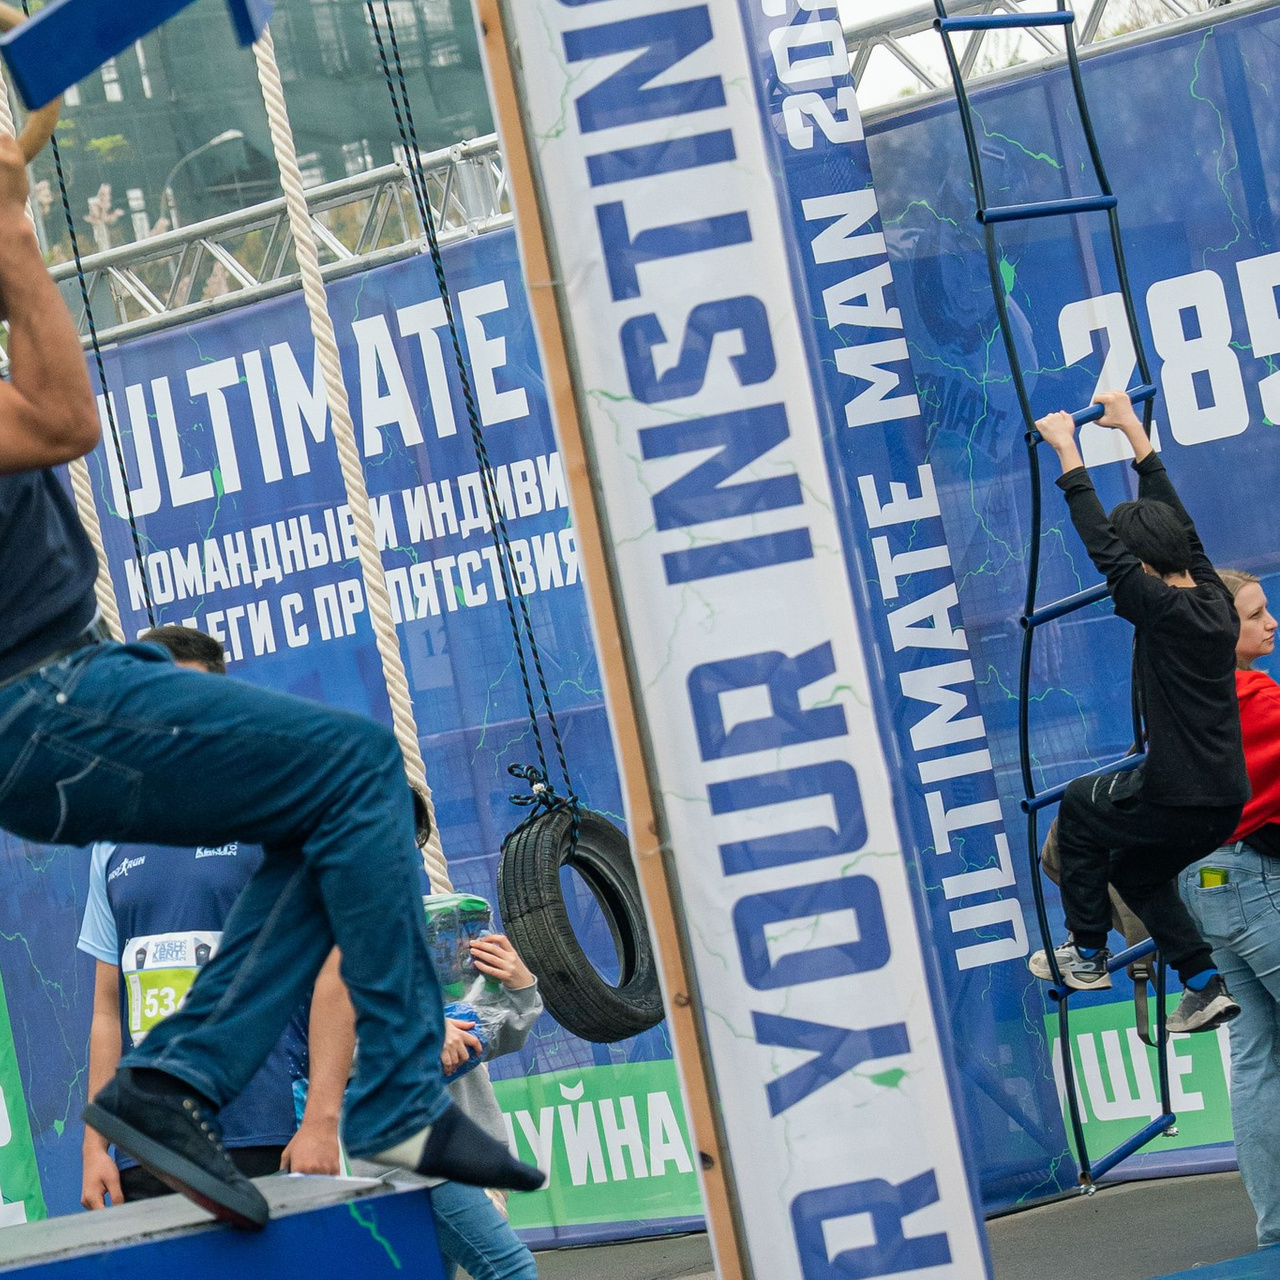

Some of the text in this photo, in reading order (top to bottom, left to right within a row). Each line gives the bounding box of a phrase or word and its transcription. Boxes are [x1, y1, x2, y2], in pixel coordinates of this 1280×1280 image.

[95, 280, 529, 520] ULTIMATE
[800, 189, 922, 428] MAN
[124, 509, 366, 612] КОМАНДНЫЕ
[285, 590, 312, 650] С
[314, 527, 588, 642] ПРПЯТСТВИЯ
[857, 462, 1030, 972] ULTIMATE
[685, 639, 910, 1119] YOUR
[503, 1079, 696, 1192] УЙНА
